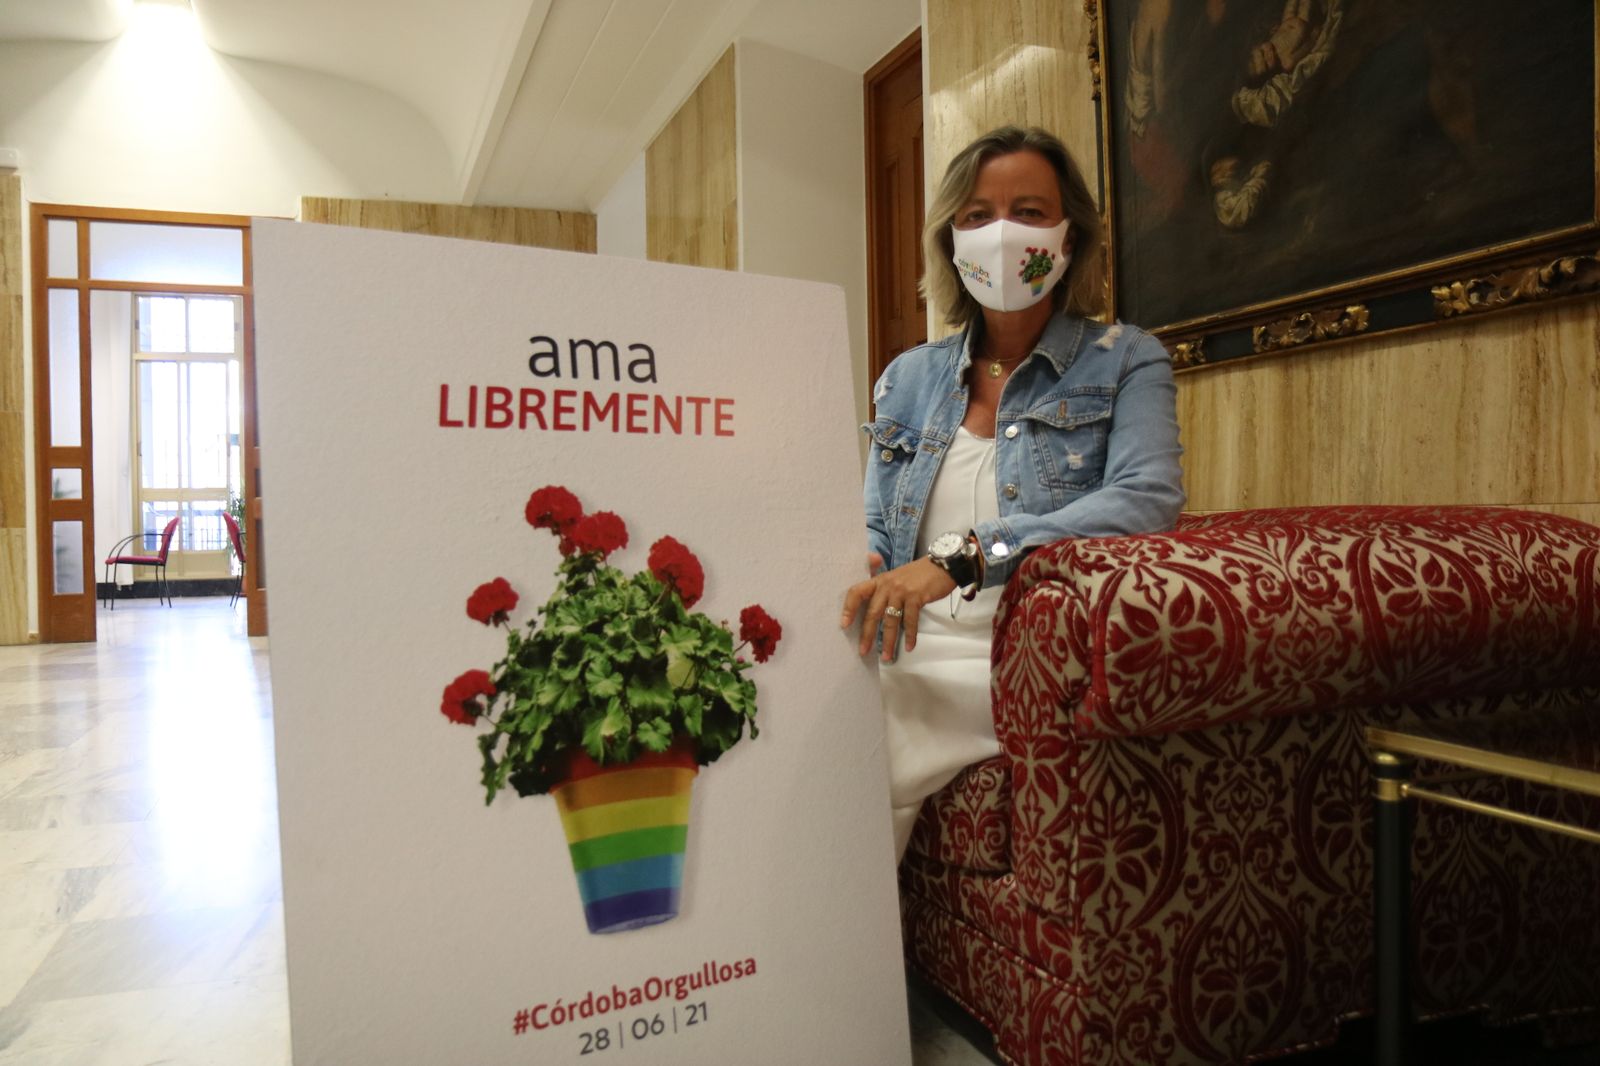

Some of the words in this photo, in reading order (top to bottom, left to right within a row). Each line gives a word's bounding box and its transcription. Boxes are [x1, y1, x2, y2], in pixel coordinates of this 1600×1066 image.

[528, 335, 658, 384] ama
[438, 383, 736, 437] LIBREMENTE
[513, 957, 757, 1036] #CórdobaOrgullosa
